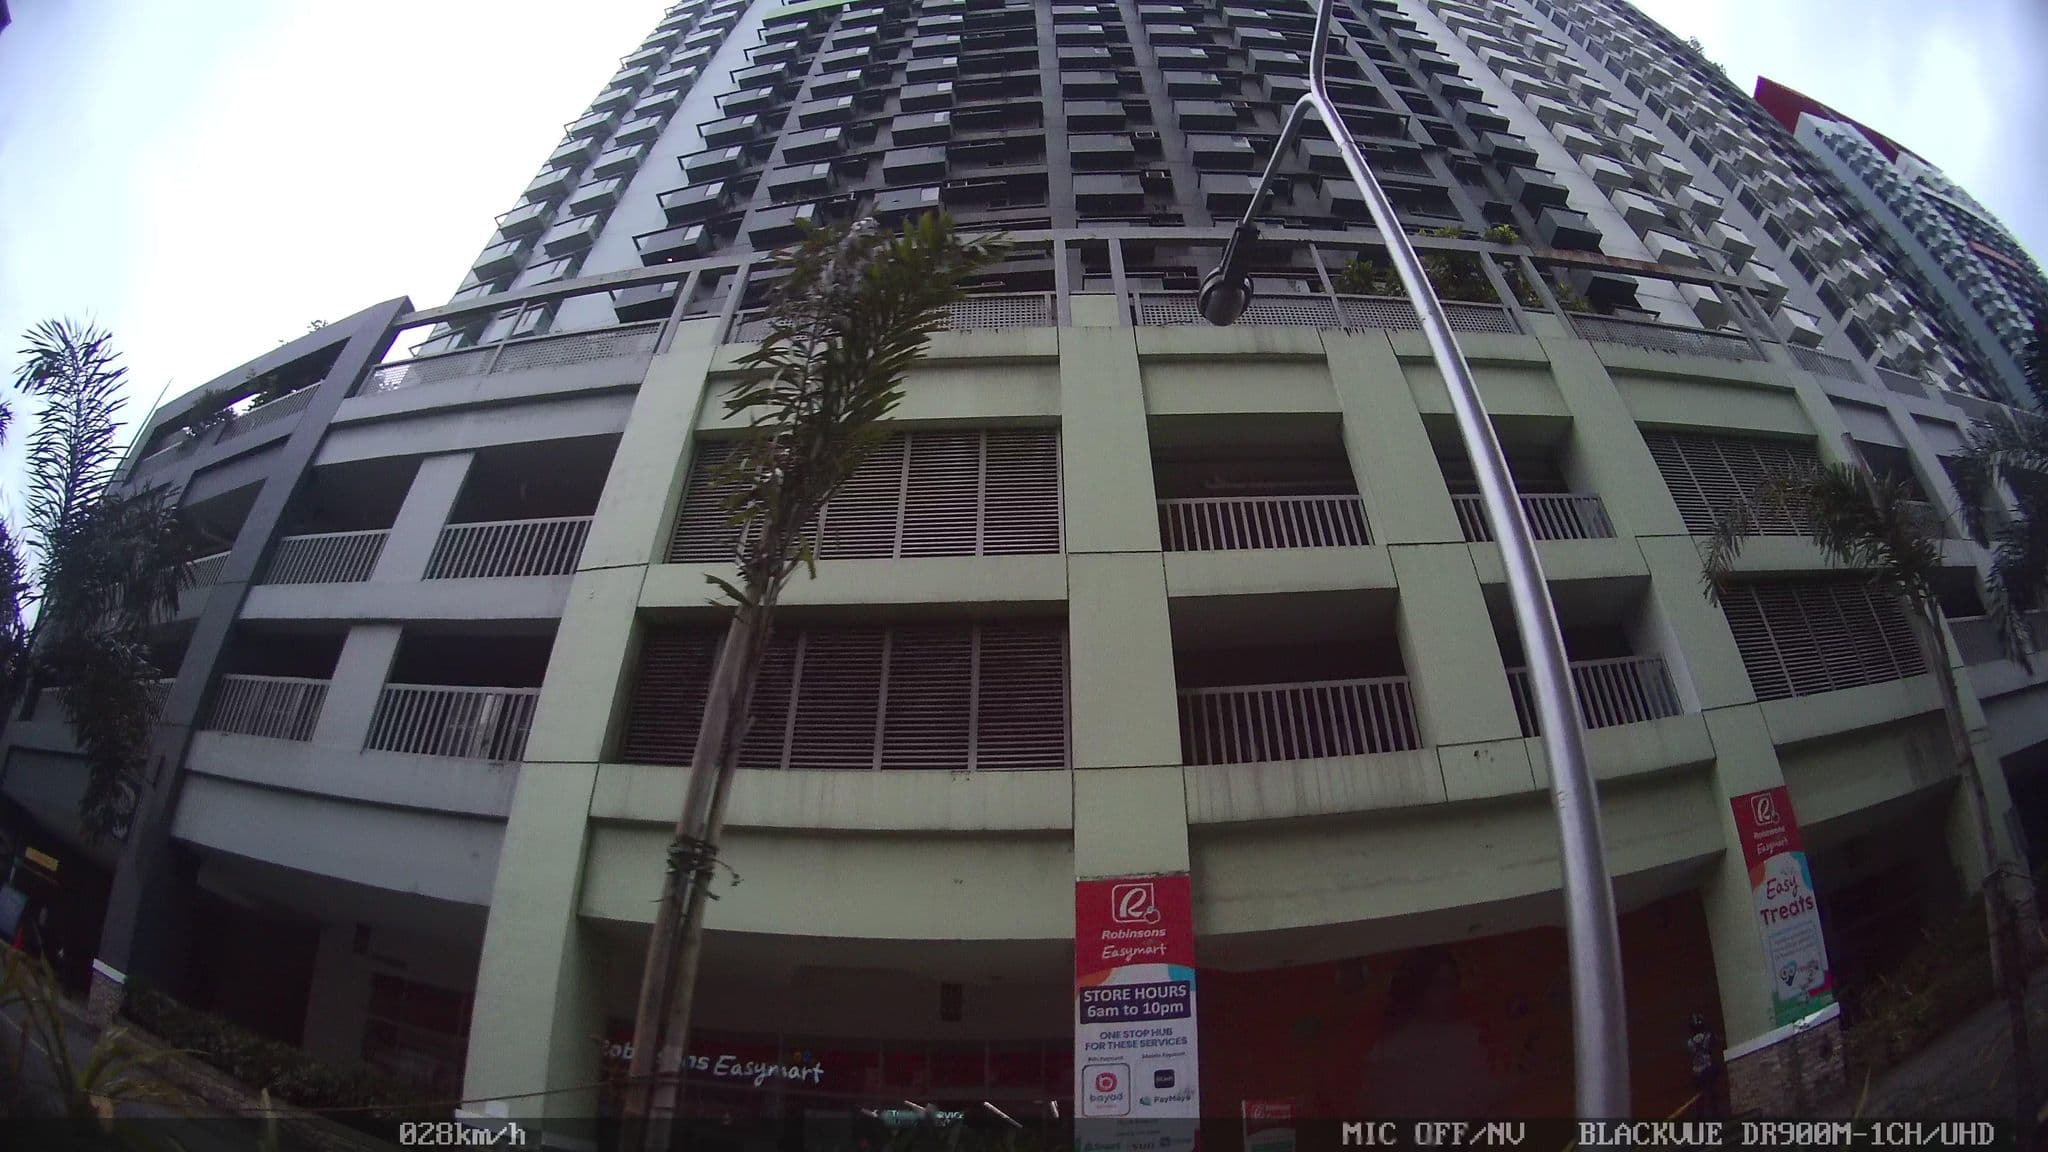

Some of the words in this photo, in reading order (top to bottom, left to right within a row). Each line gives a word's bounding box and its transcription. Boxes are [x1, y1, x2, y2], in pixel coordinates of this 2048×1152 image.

[1766, 874, 1799, 900] Easy
[1760, 895, 1815, 925] Treats
[1101, 928, 1167, 940] Robinsons
[1101, 943, 1167, 962] Easymart
[1083, 988, 1132, 1002] STORE
[1134, 985, 1187, 1000] HOURS
[1087, 1005, 1119, 1018] 6am
[1124, 1003, 1139, 1016] to
[1143, 1002, 1184, 1016] 10pm
[1099, 1031, 1121, 1040] ONE
[1123, 1030, 1150, 1039] STOP
[1151, 1027, 1173, 1037] HUB
[1085, 1041, 1106, 1051] FOR
[1108, 1039, 1138, 1050] THESE
[1139, 1036, 1188, 1048] SERVICES
[712, 1055, 825, 1087] Easymart
